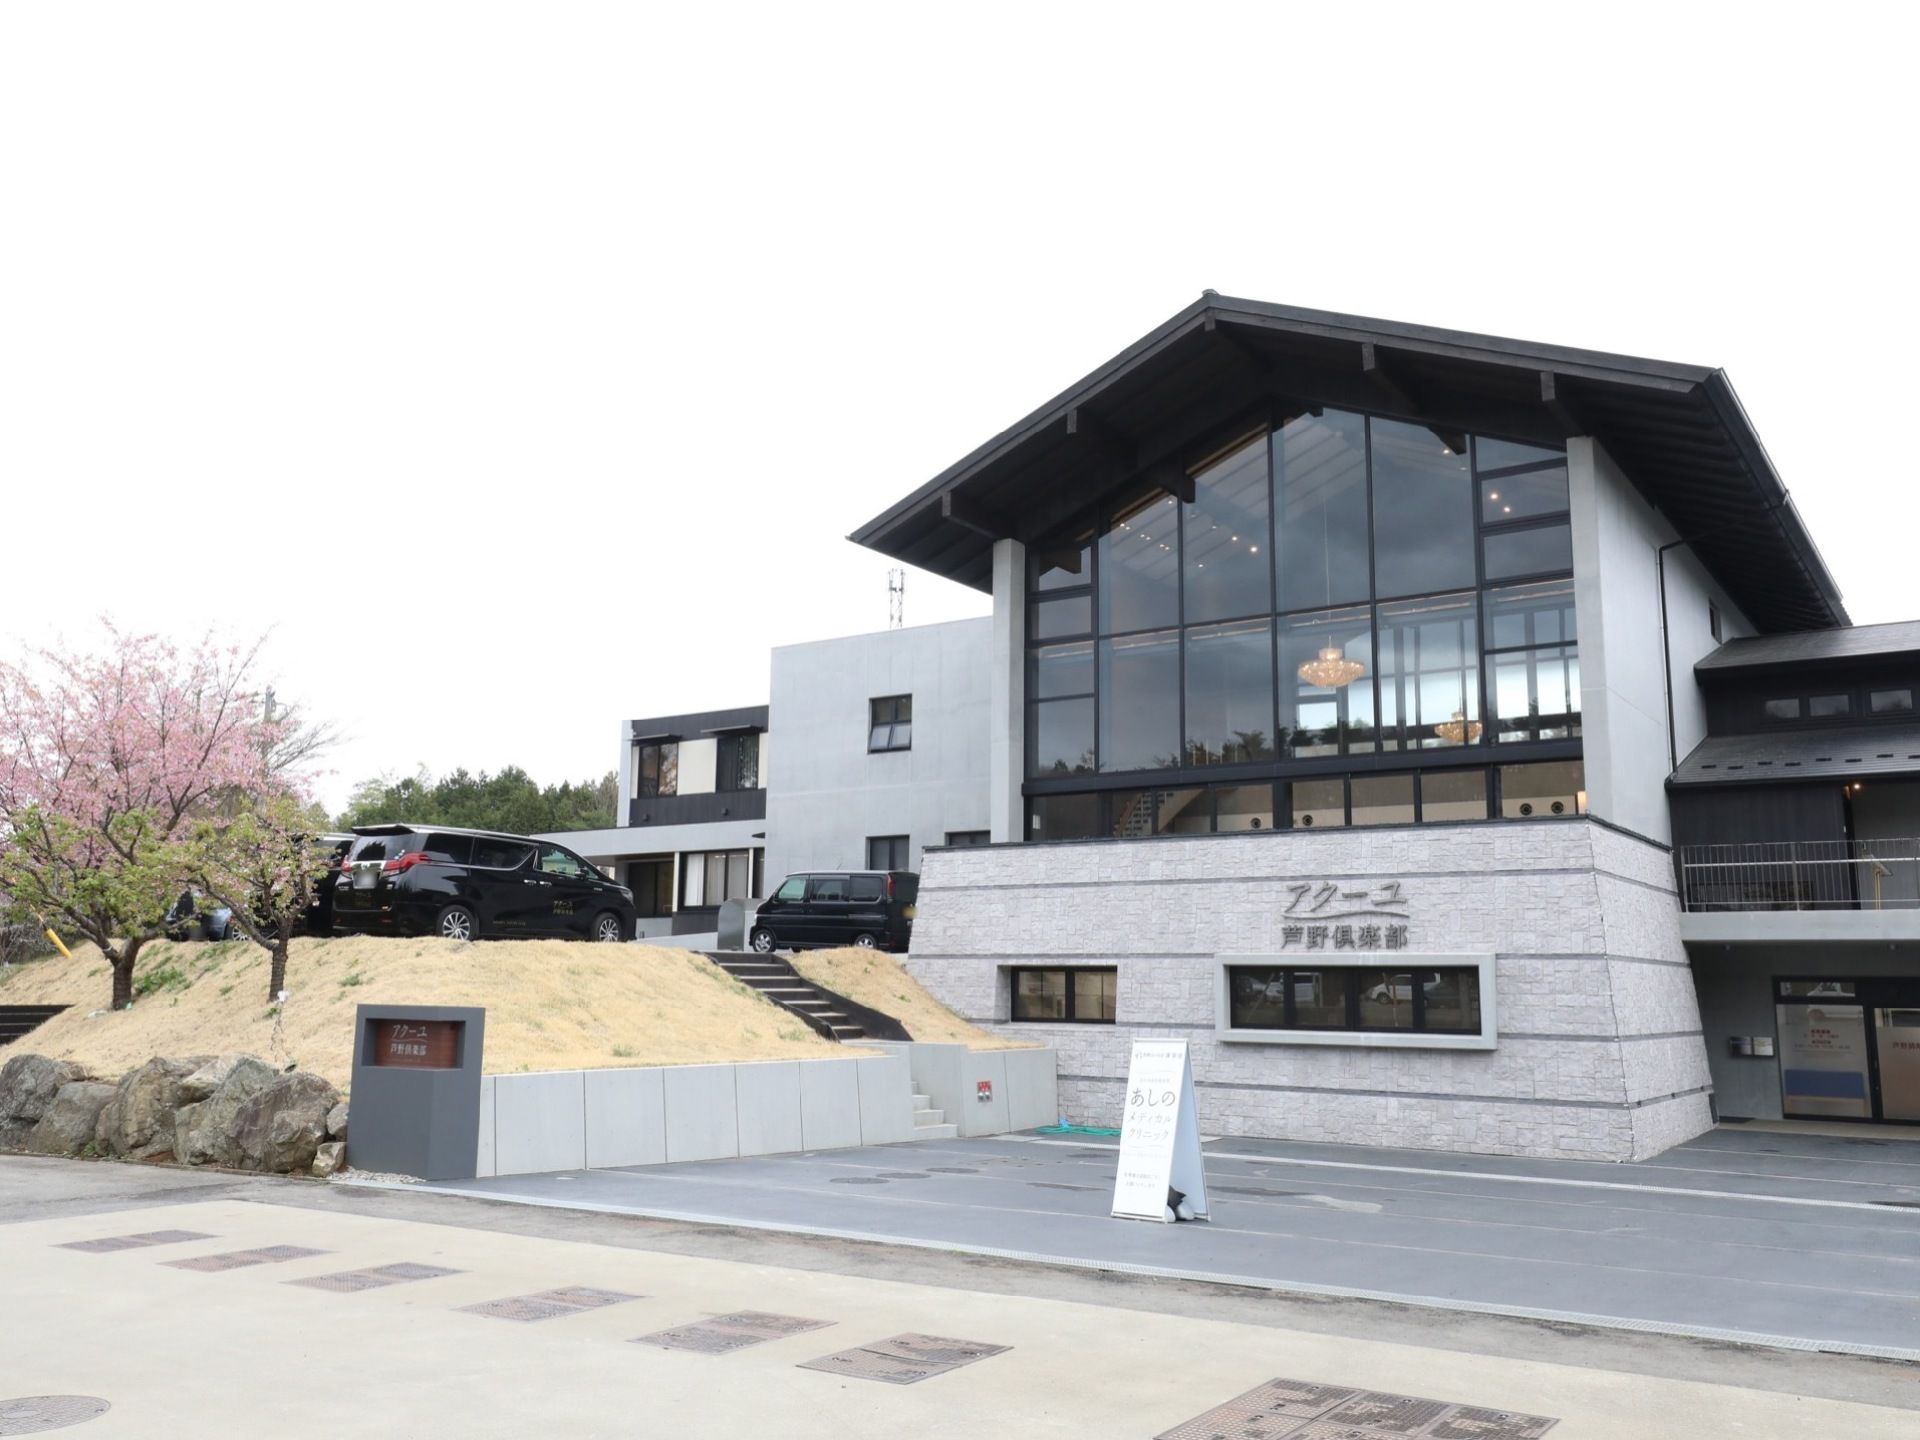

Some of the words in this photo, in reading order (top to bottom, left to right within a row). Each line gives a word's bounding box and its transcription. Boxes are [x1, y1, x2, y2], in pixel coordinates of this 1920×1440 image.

[1284, 881, 1408, 912] アクーユ
[1280, 924, 1408, 950] 芦野倶楽部
[392, 1024, 427, 1038] アクーユ
[1130, 1087, 1176, 1107] あしの
[1127, 1127, 1169, 1140] クリニック
